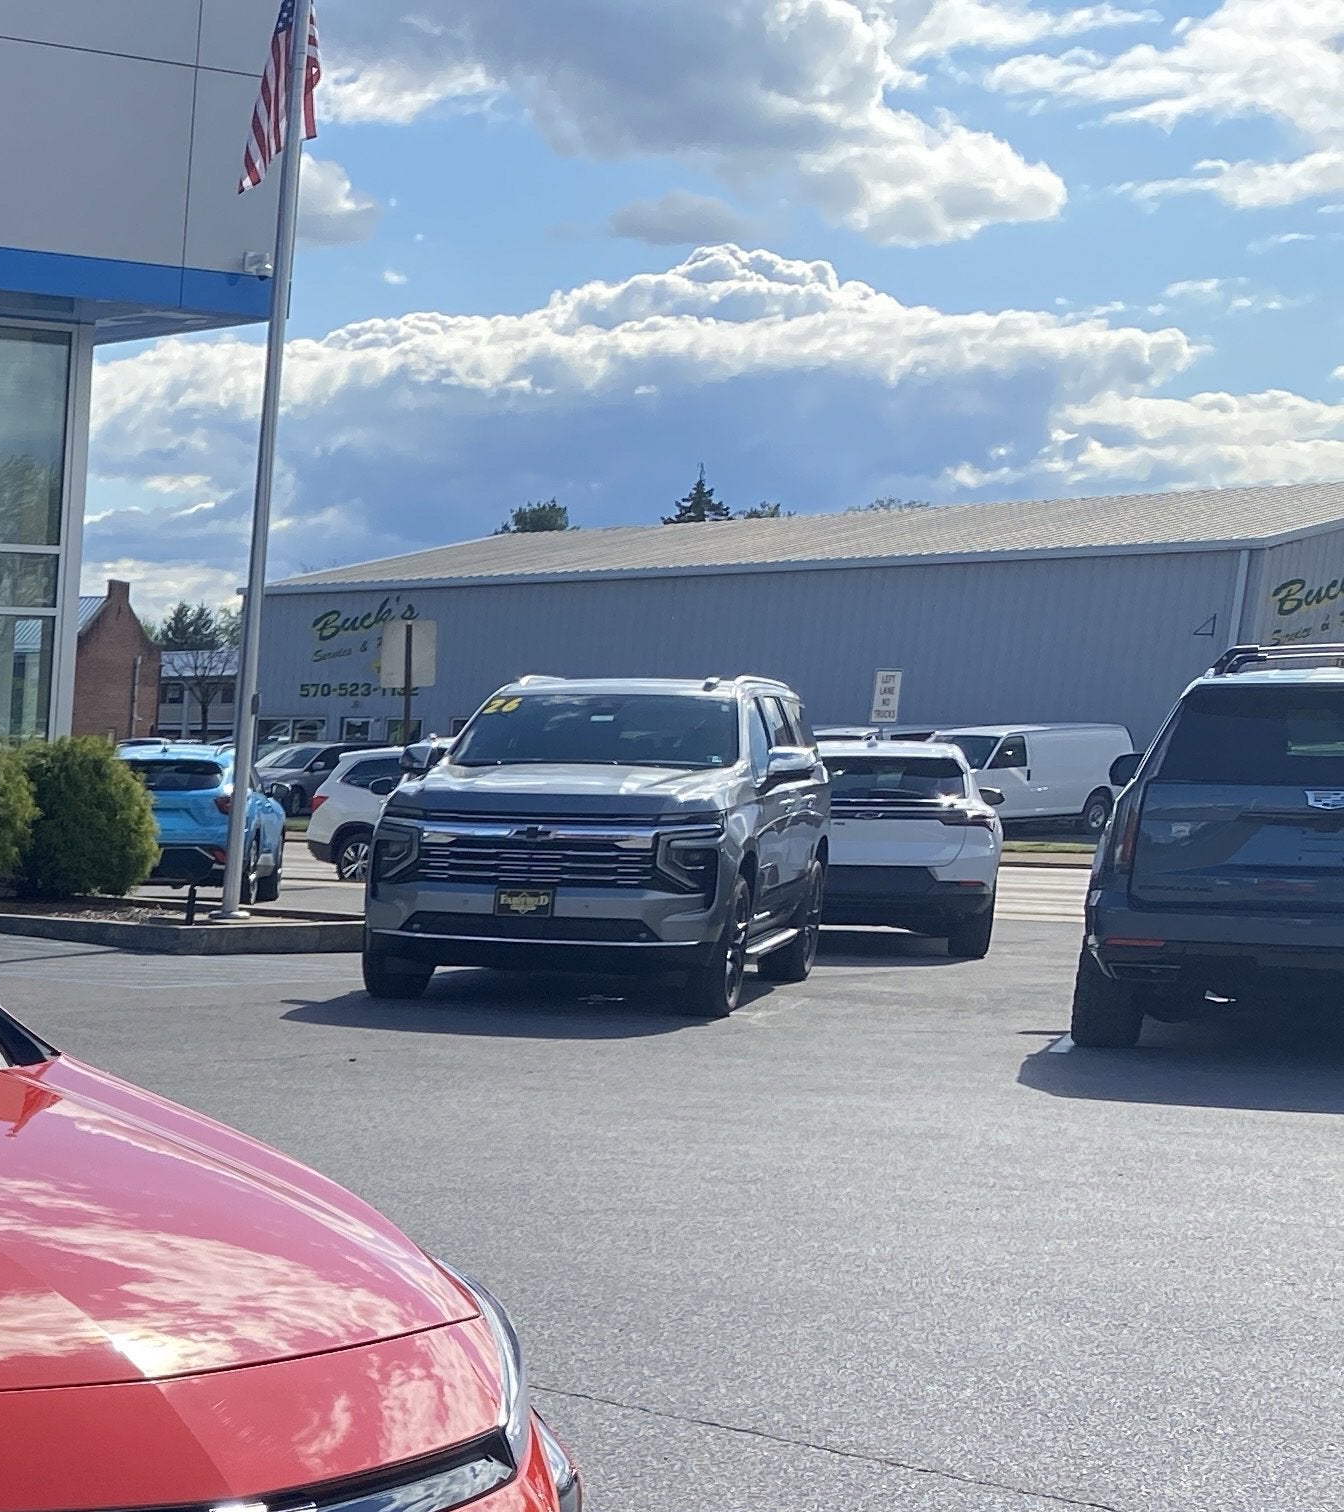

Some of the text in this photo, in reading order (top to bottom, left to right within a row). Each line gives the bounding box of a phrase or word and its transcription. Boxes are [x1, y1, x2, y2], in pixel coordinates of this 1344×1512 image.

[1272, 578, 1344, 615] Buc
[312, 596, 420, 641] Buck's
[881, 674, 896, 684] LEFT
[879, 686, 896, 696] LANE
[482, 697, 523, 715] 26
[881, 697, 891, 707] NO
[873, 709, 896, 719] TRUCKS
